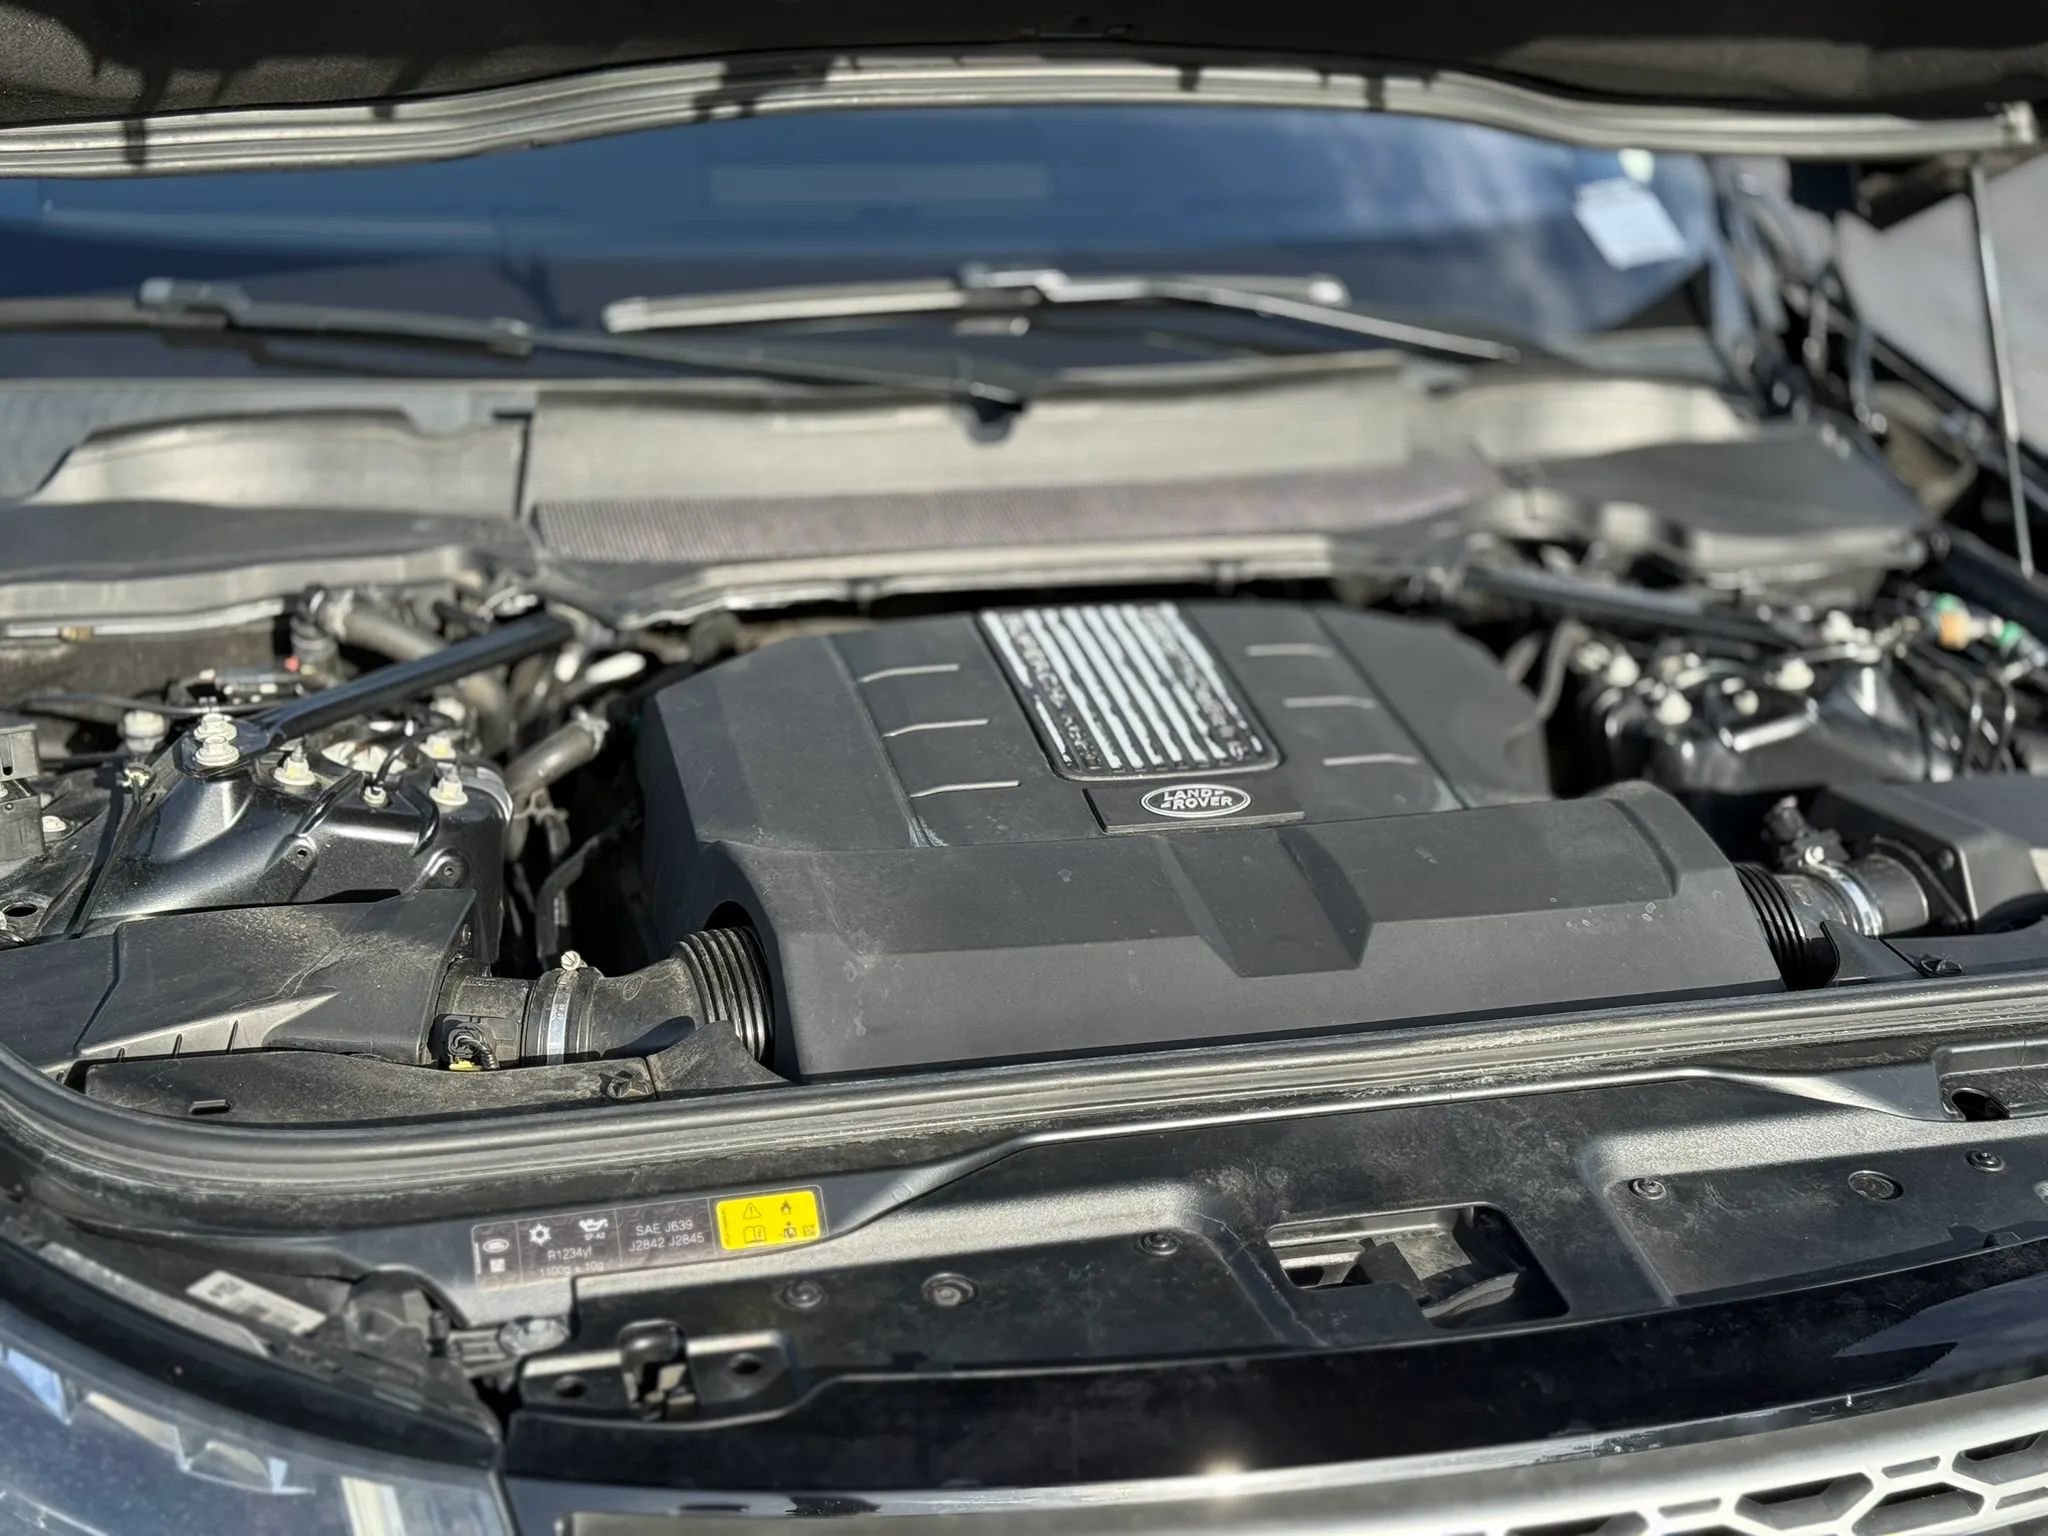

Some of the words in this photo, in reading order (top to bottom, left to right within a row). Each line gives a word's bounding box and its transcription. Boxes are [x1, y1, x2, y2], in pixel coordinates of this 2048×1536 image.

[1164, 788, 1211, 801] LAND
[1173, 795, 1233, 810] ROVER
[635, 1222, 661, 1237] SAE
[664, 1218, 694, 1233] J639
[628, 1236, 666, 1252] J2842
[668, 1232, 705, 1247] J2845
